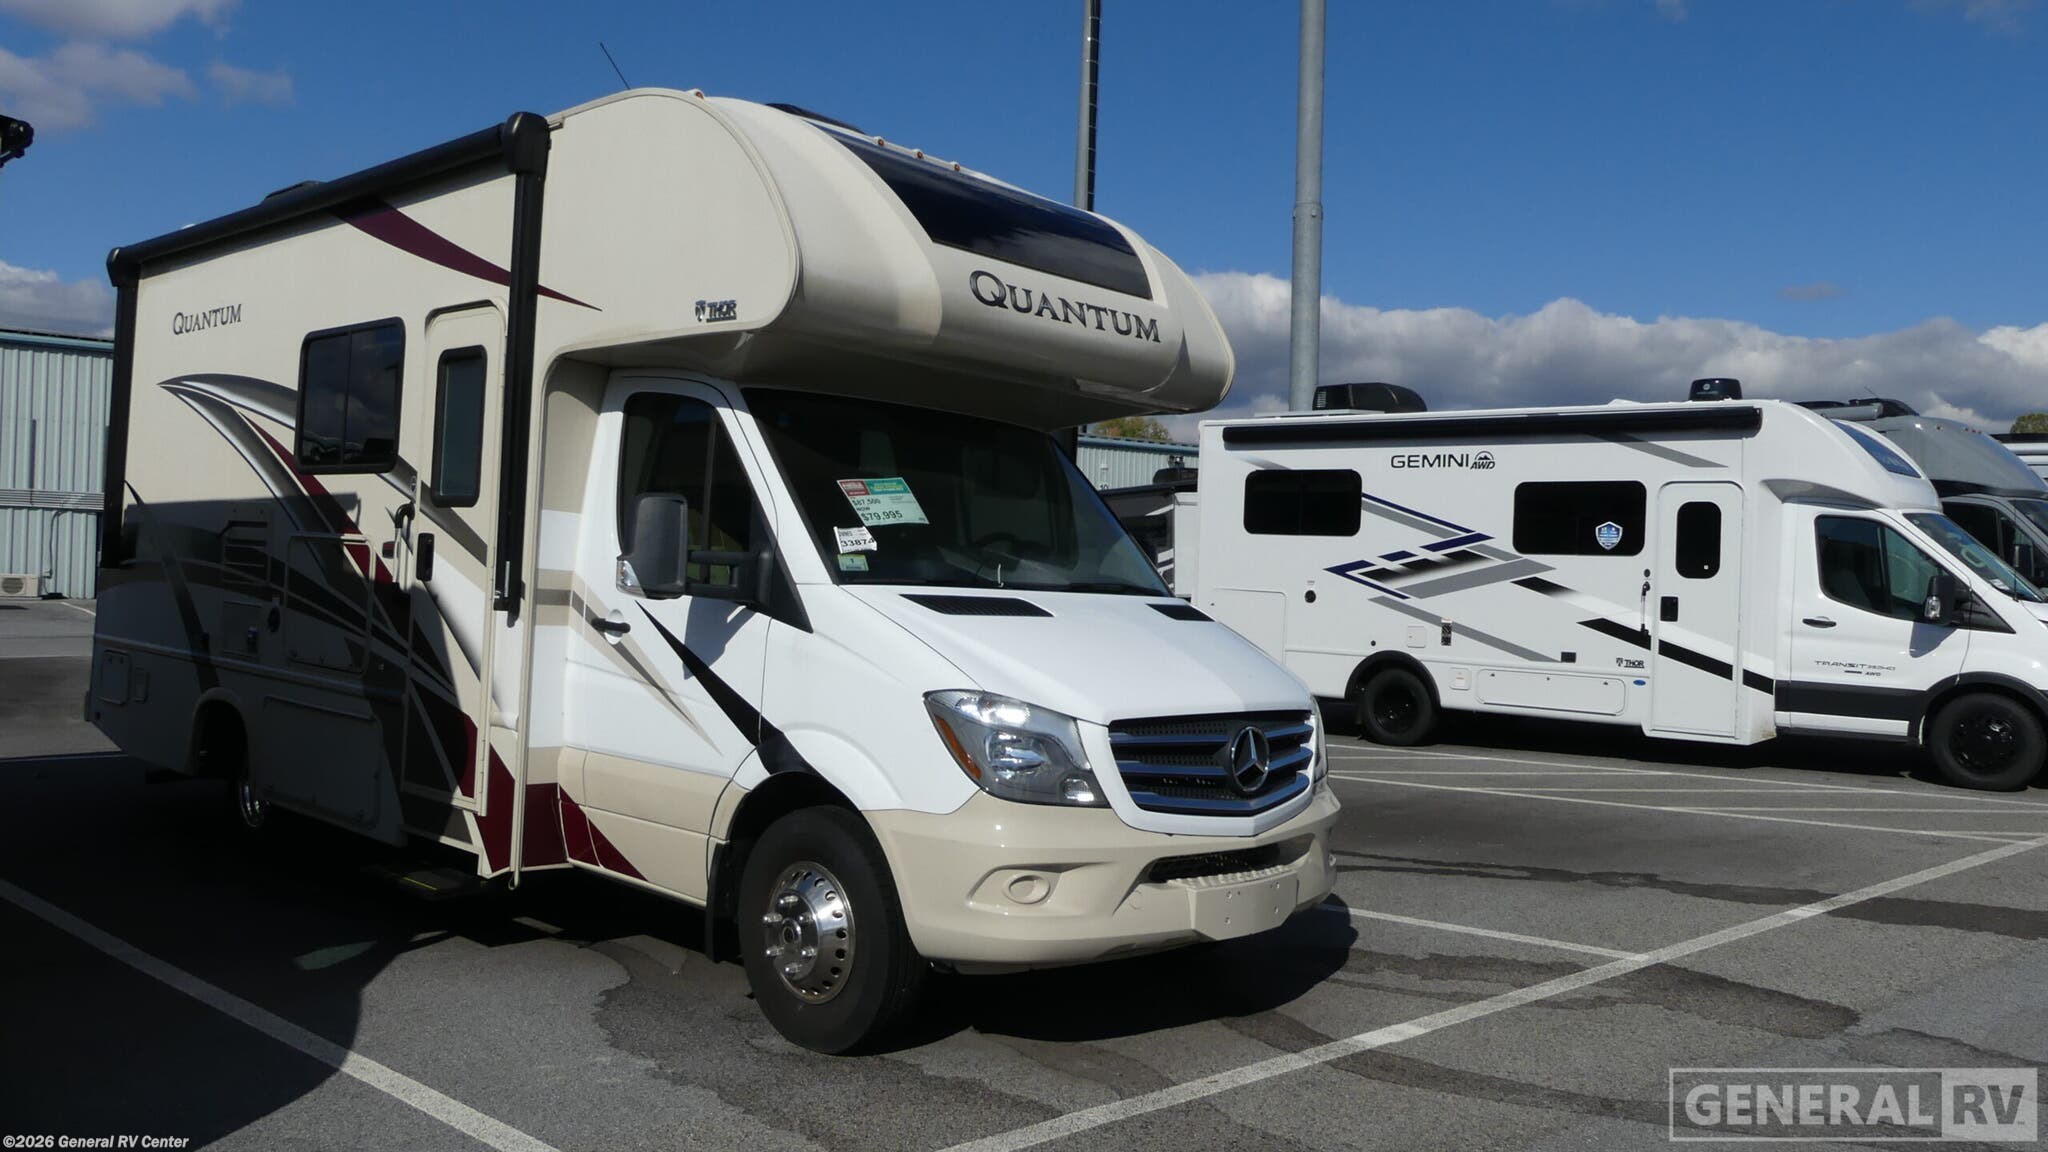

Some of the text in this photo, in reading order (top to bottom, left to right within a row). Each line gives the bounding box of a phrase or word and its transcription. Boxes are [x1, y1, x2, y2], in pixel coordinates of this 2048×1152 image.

[706, 300, 737, 321] THOR
[969, 270, 1161, 343] QUANTUM
[173, 303, 242, 335] QUANTUM
[1391, 453, 1496, 470] GEMINI AWD
[861, 510, 903, 521] $79,995
[1624, 659, 1645, 668] THOR
